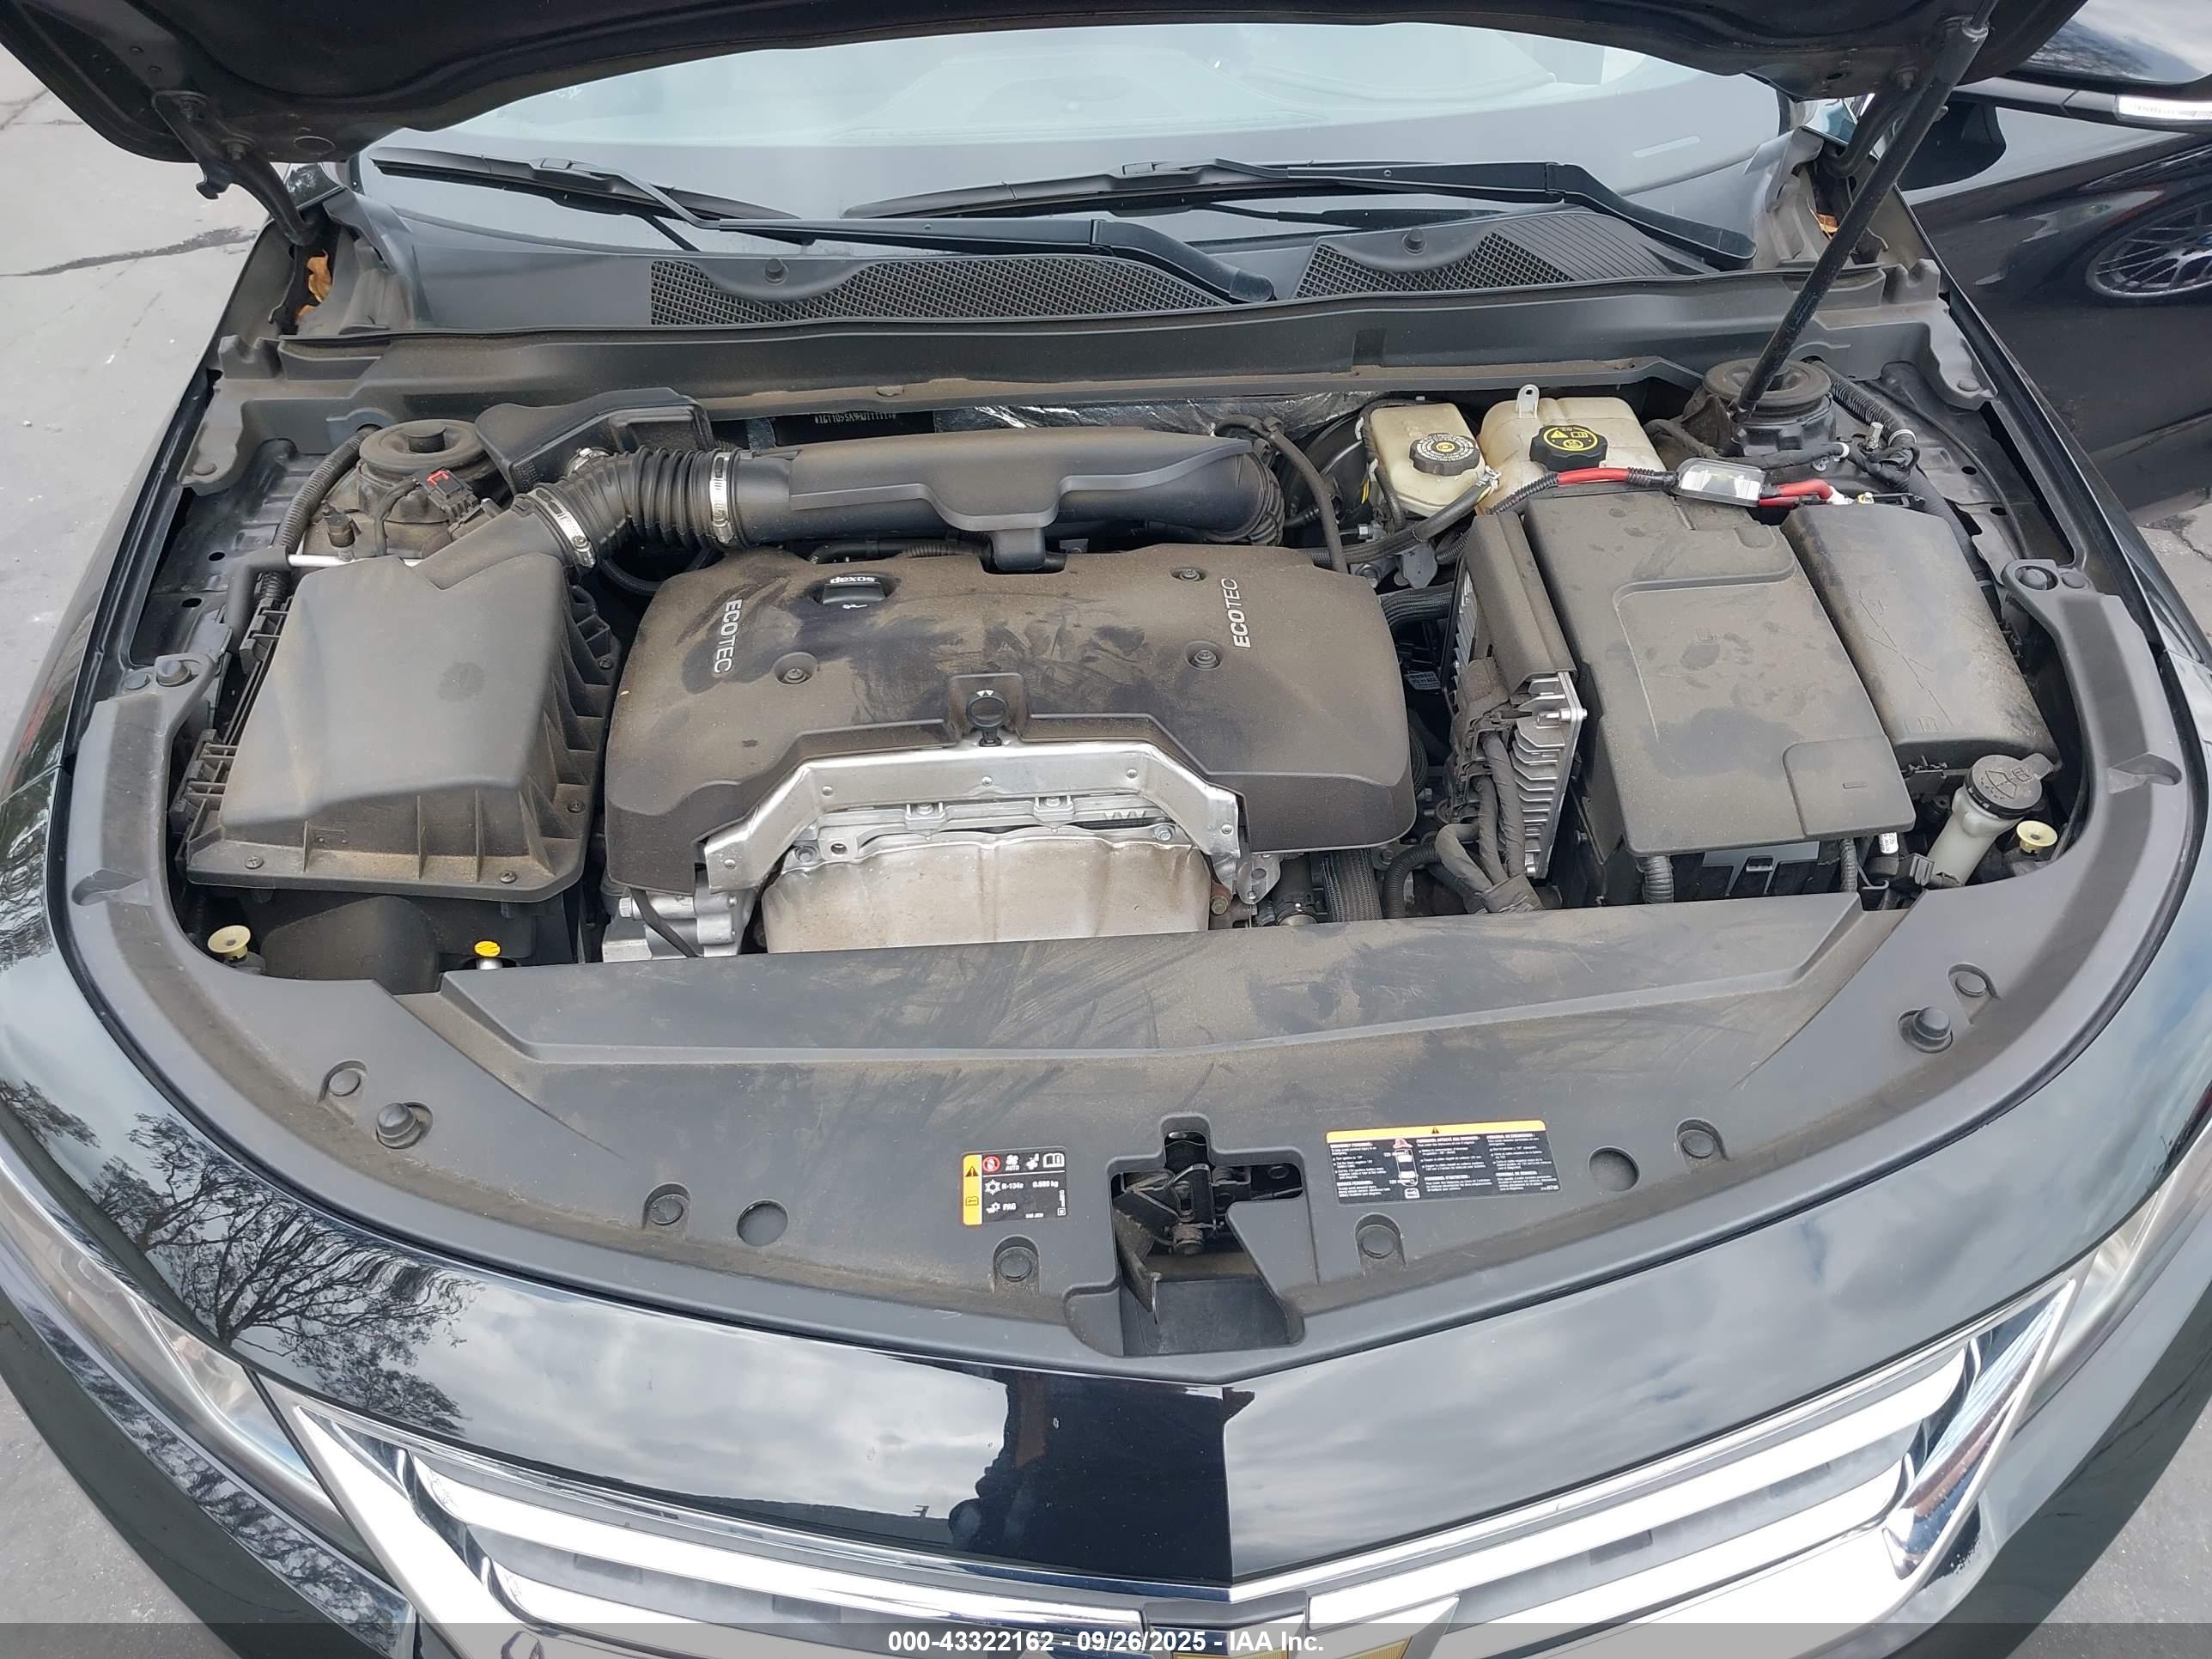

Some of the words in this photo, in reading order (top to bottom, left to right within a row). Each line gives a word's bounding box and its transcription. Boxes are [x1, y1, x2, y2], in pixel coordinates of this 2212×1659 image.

[830, 574, 876, 585] dexos
[1220, 578, 1252, 648] ECOTEC
[714, 599, 743, 674] ECOTEC
